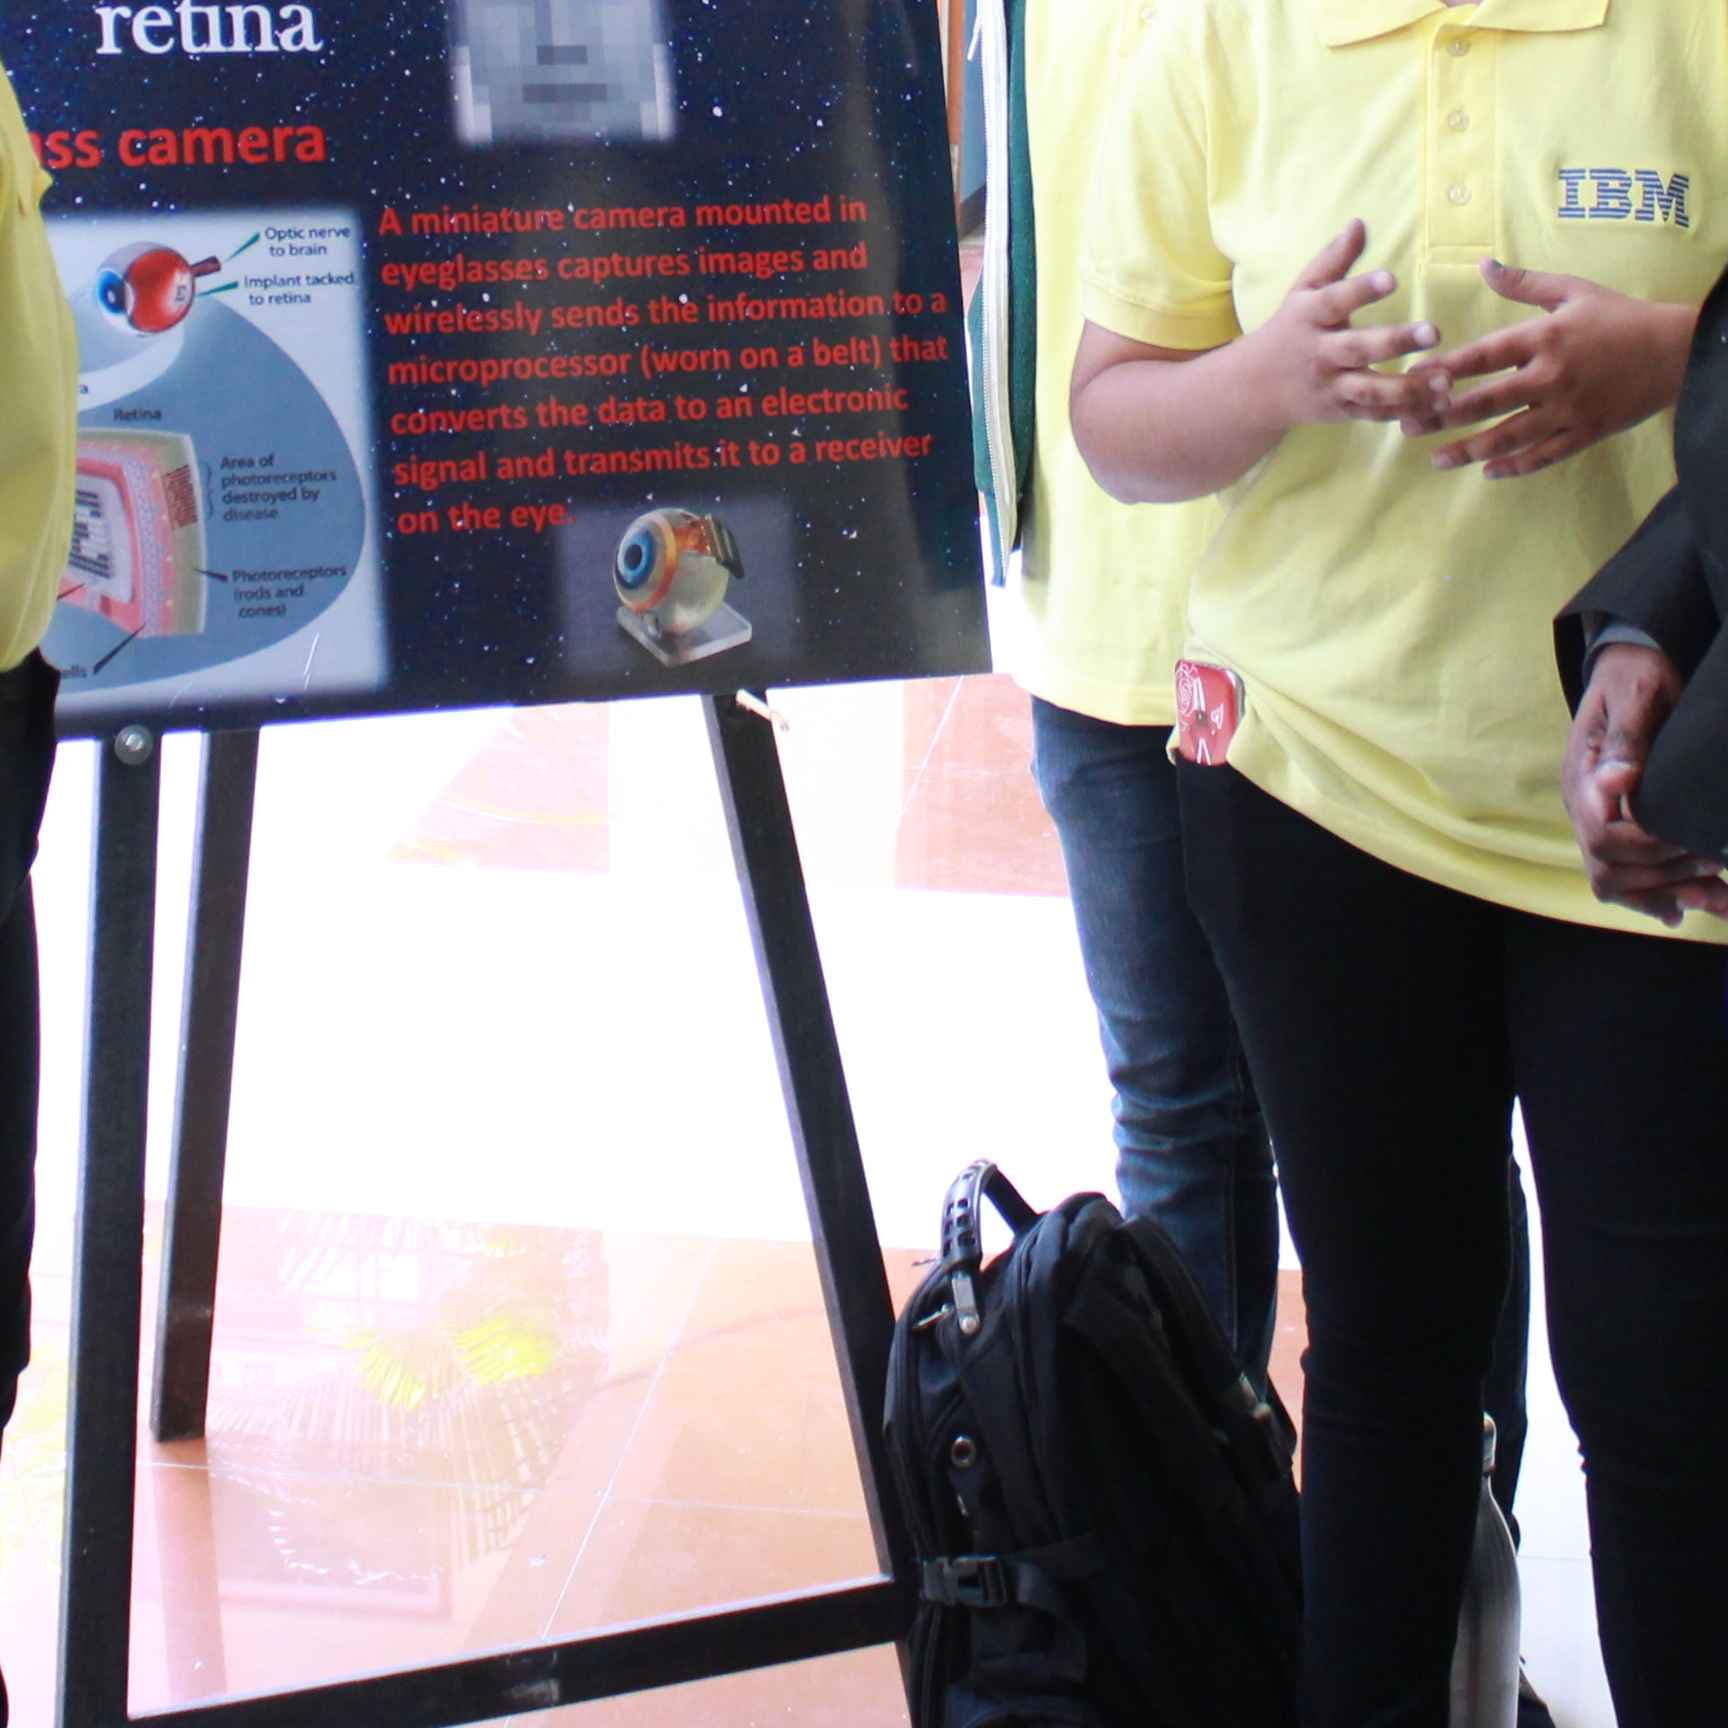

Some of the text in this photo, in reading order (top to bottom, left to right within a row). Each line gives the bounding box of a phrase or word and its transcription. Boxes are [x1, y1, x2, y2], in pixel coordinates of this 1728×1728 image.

[34, 126, 325, 170] ss camera
[1558, 169, 1689, 228] IBM
[379, 197, 831, 235] A miniature camera mounted
[264, 227, 351, 242] Optic nerve
[269, 243, 327, 257] to brain
[381, 242, 867, 290] eyeglasses captures images and
[244, 271, 354, 290] Implant tacked
[249, 292, 311, 305] to retina
[383, 290, 885, 335] wirelessly sends the information
[387, 335, 948, 386] microprocessor (worn belt) that
[113, 408, 161, 421] Retina
[391, 384, 908, 434] converts the data electronic
[221, 452, 274, 469] Area of
[392, 433, 933, 491] signal and transmits receiver
[222, 469, 337, 488] photoreceptors
[222, 488, 320, 505] destroyed by
[223, 508, 279, 521] disease
[448, 501, 576, 537] the eye.
[232, 566, 347, 583] Photoreceptors
[275, 584, 304, 598] and
